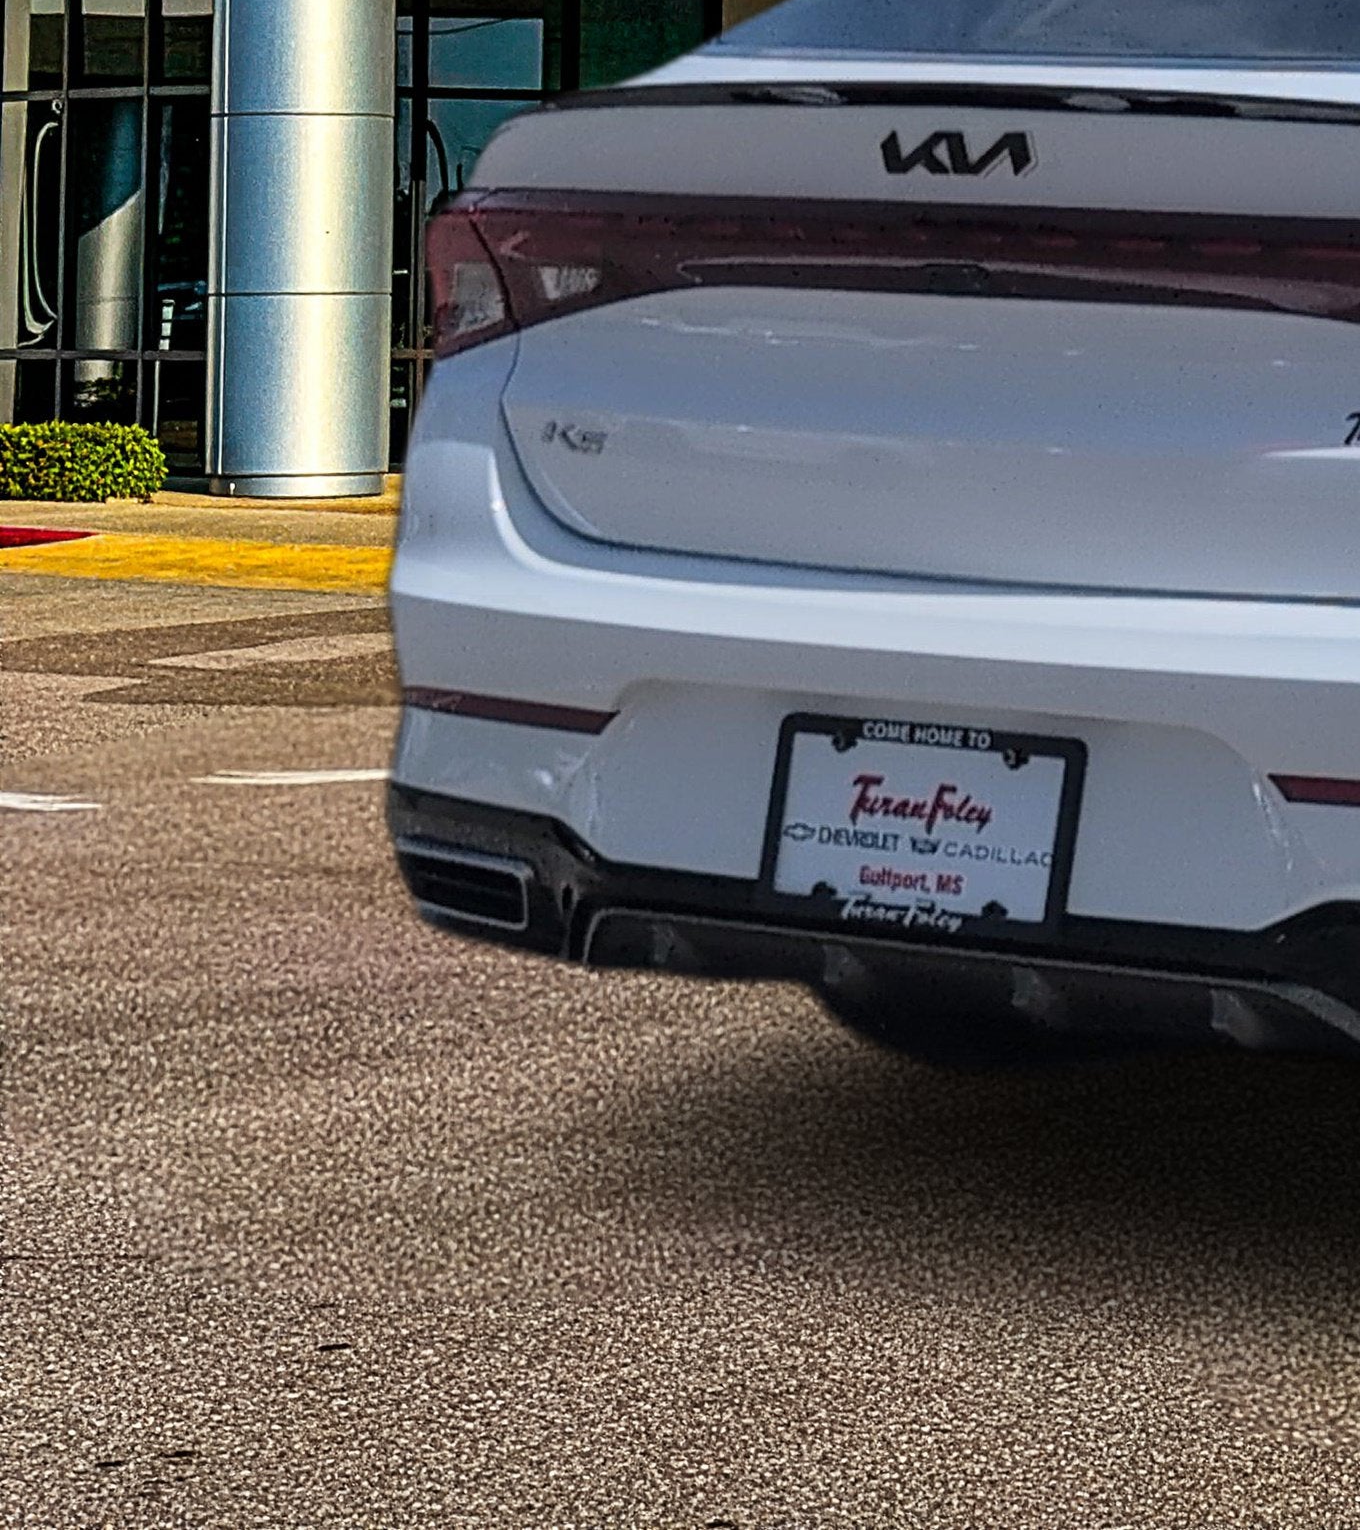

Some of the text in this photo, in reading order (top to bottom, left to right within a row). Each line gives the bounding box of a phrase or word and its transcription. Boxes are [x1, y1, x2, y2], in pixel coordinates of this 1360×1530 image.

[879, 129, 1035, 178] KIA
[862, 722, 991, 750] COME HOME TO
[943, 843, 1053, 869] CADILLAC
[936, 874, 965, 896] MS
